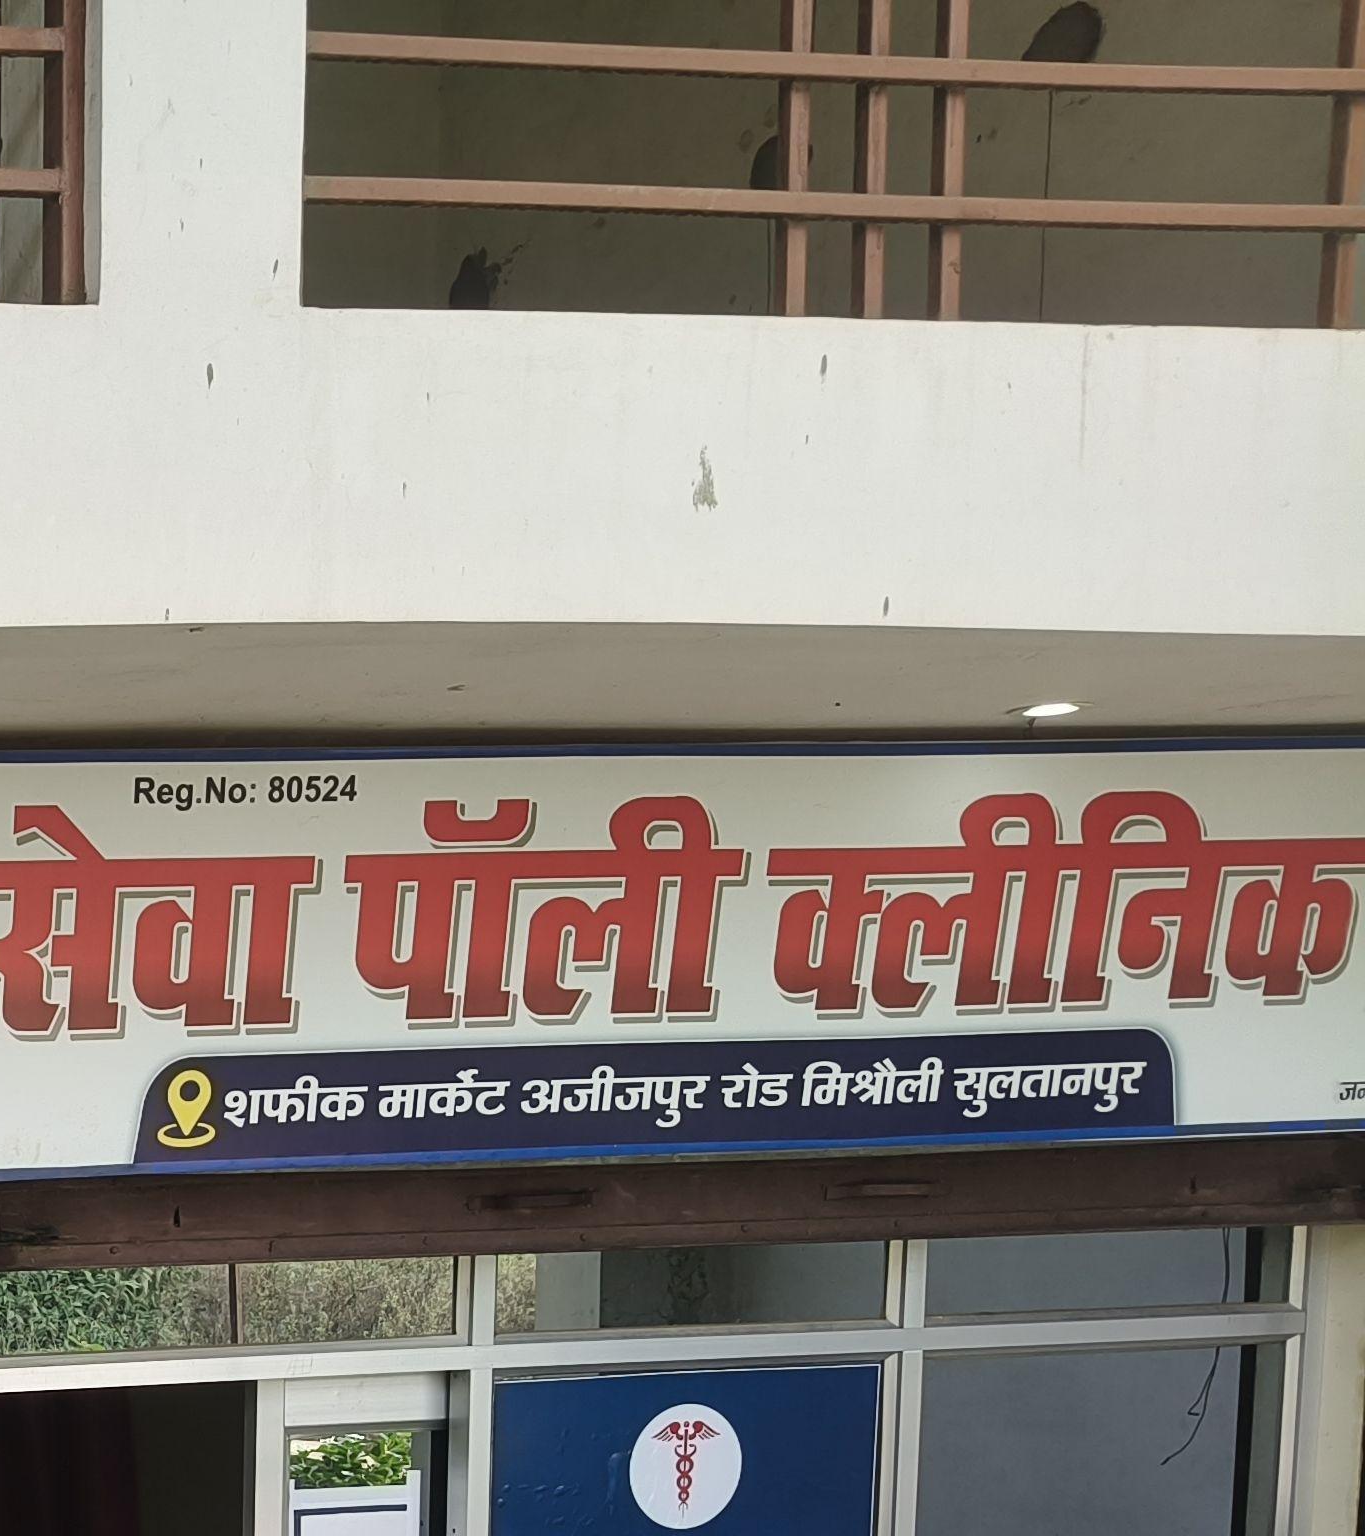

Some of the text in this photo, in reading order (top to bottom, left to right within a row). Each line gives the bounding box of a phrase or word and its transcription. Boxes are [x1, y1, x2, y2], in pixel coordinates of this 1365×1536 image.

[133, 775, 357, 811] Reg.No: 80524
[345, 796, 745, 1022] पॉली
[767, 791, 1365, 1012] क्लीनिक
[223, 1056, 1147, 1129] शफीक मार्केट अजीजपुर रोड मिश्रौली सुलतानपुर
